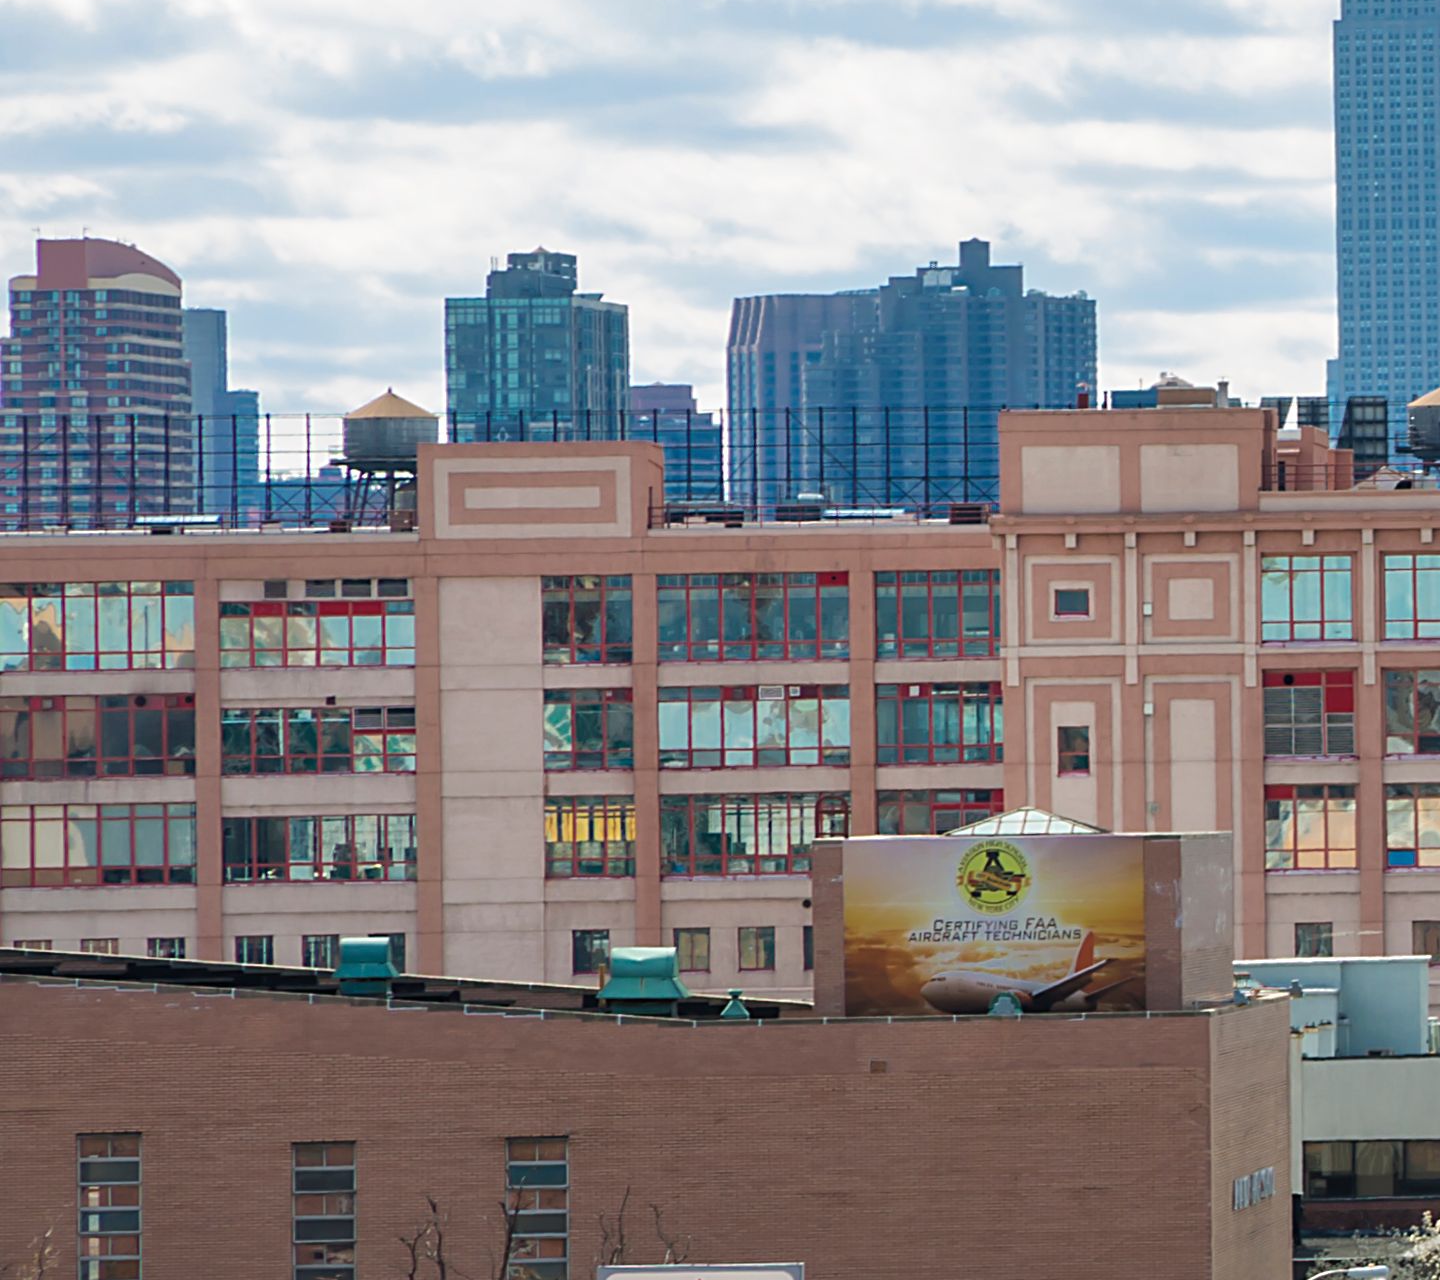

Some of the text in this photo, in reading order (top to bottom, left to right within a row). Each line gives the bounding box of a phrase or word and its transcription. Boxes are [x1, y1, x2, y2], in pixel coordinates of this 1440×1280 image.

[1025, 917, 1057, 930] FAA
[908, 929, 1082, 943] AIRCRAFT TECHNICIANS
